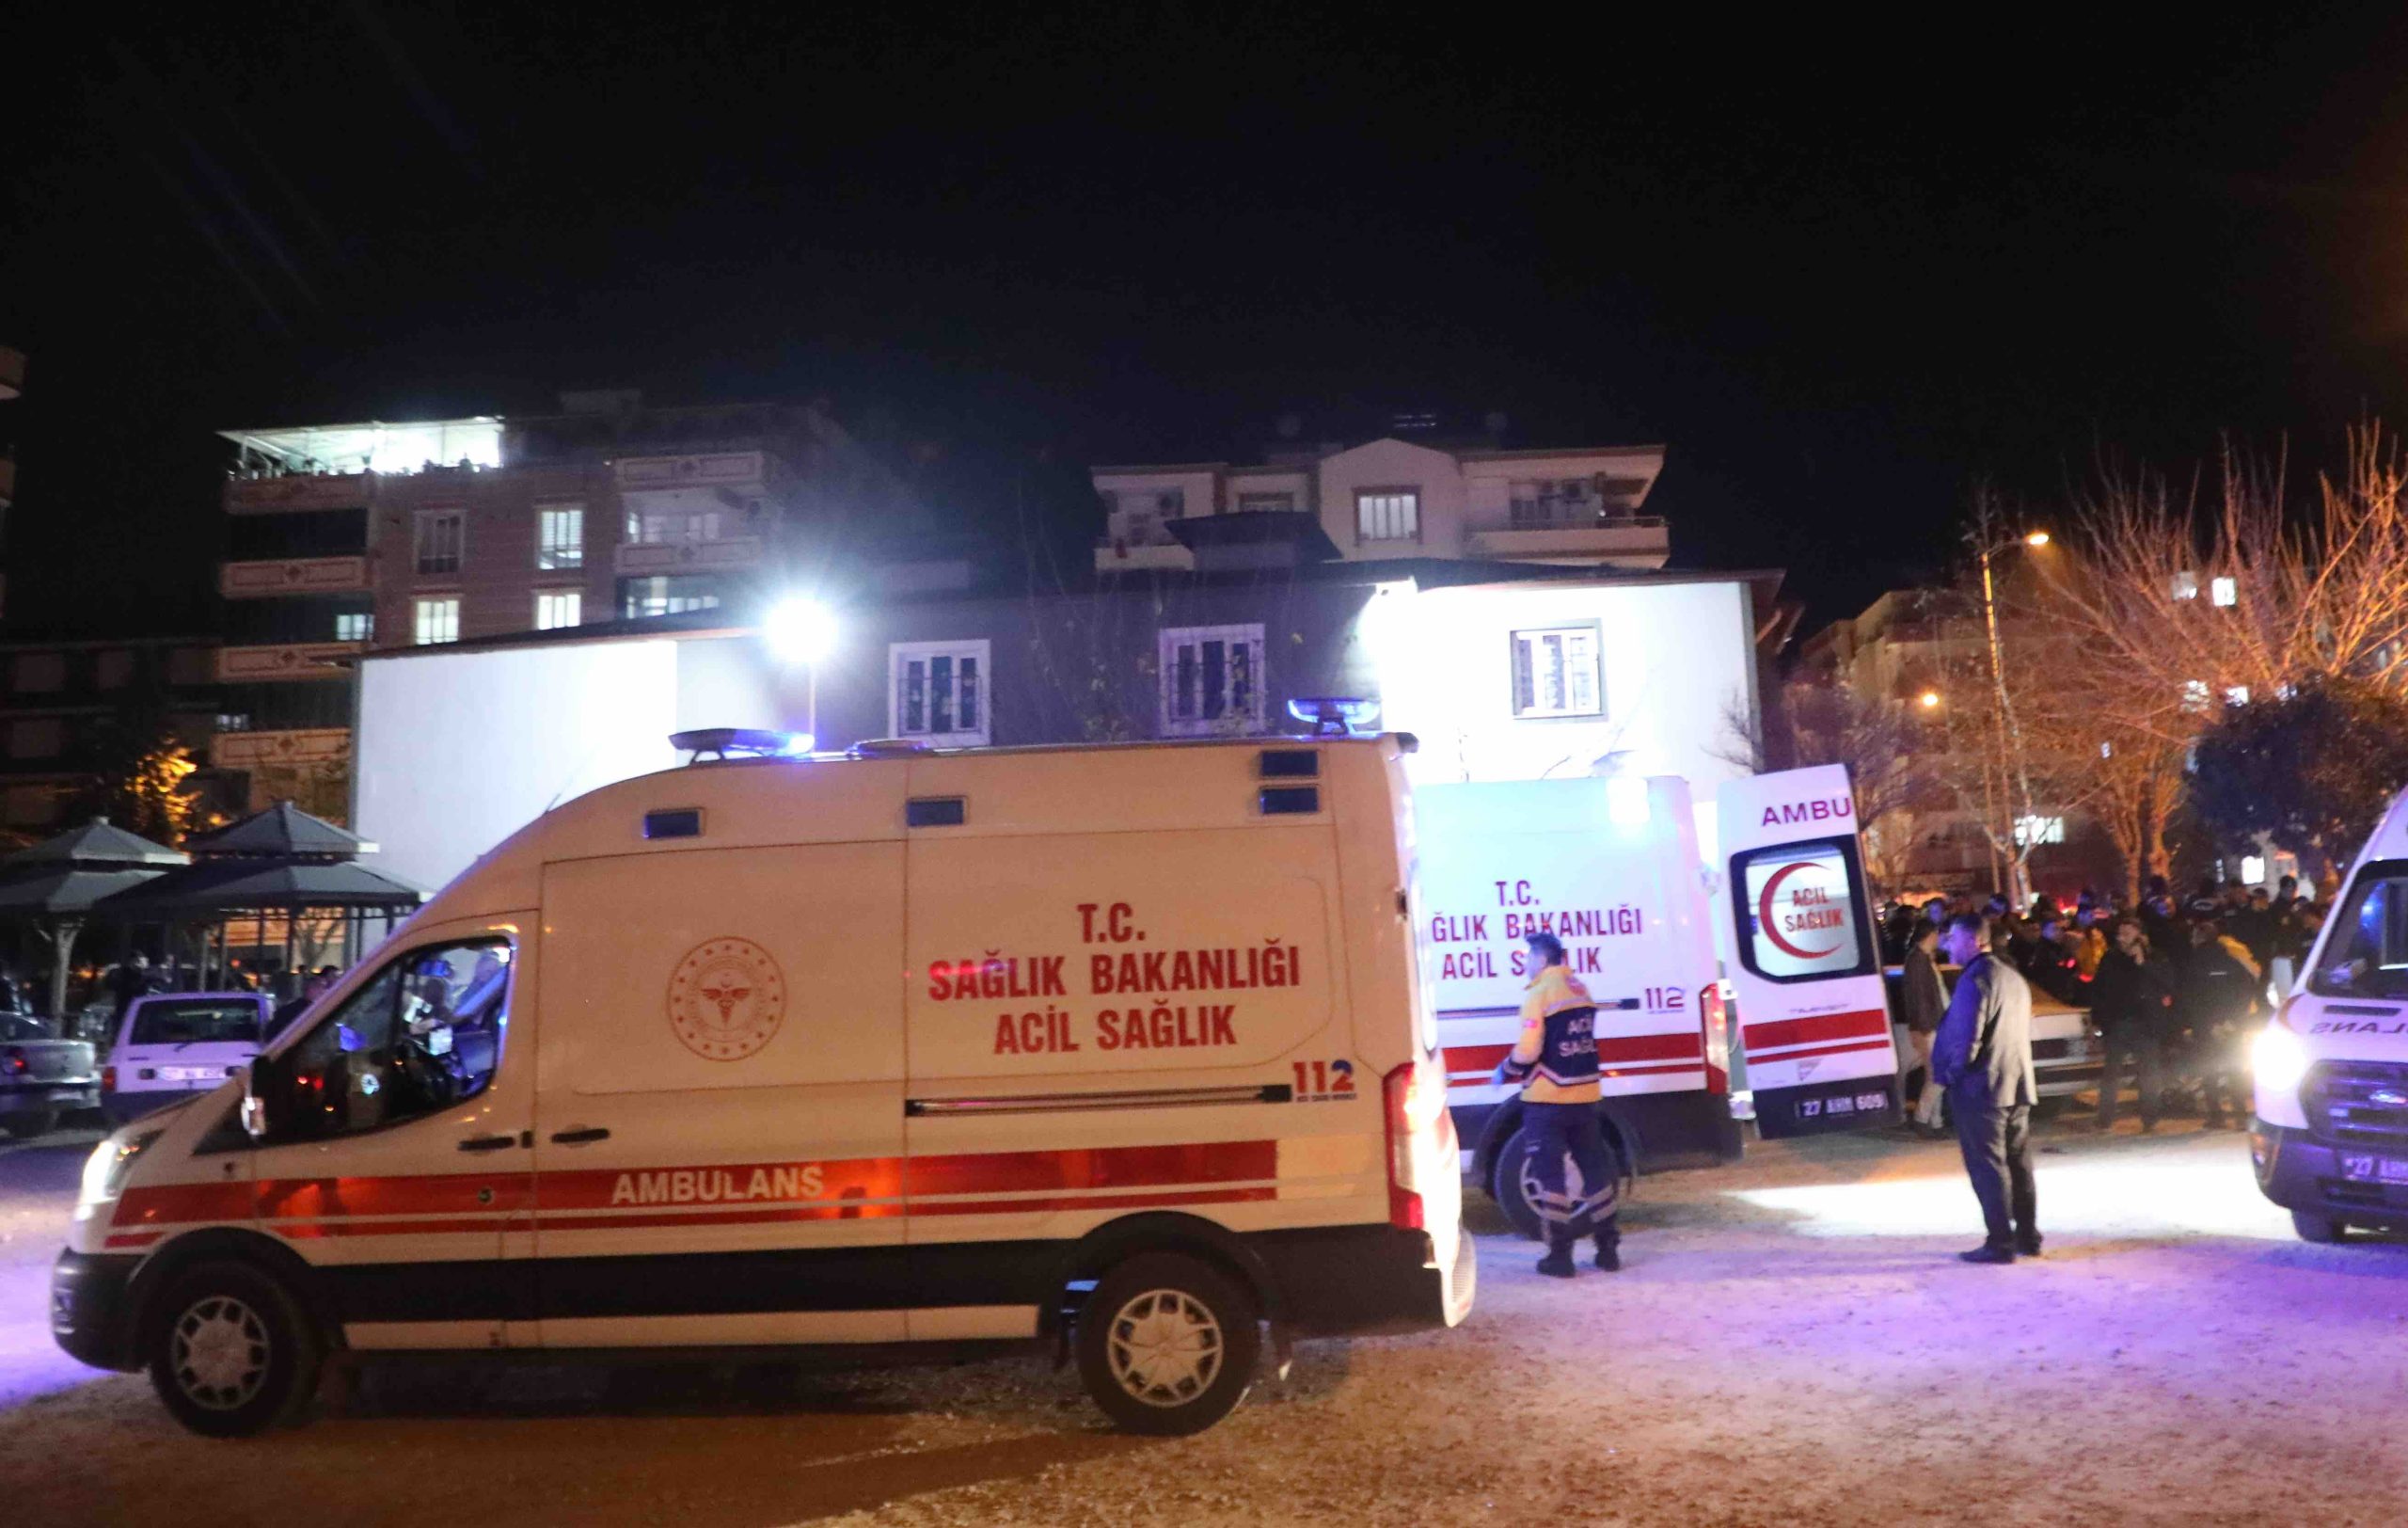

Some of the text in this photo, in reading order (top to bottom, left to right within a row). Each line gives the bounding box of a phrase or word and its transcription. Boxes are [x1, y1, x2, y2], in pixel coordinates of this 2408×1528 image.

[1762, 798, 1851, 826] AMBU
[1495, 880, 1540, 906] T.C.
[1078, 902, 1145, 943] T.C.
[1432, 904, 1642, 943] ĞLIK BAKANLIĞI
[928, 938, 1300, 1001] SAĞLIK BAKANLIĞI
[1442, 947, 1603, 979] ACİL SLIK
[1645, 987, 1686, 1010] 112
[993, 999, 1238, 1054] ACİL SAĞLIK
[1293, 1059, 1354, 1093] 112
[612, 1167, 825, 1204] AMBULANS
